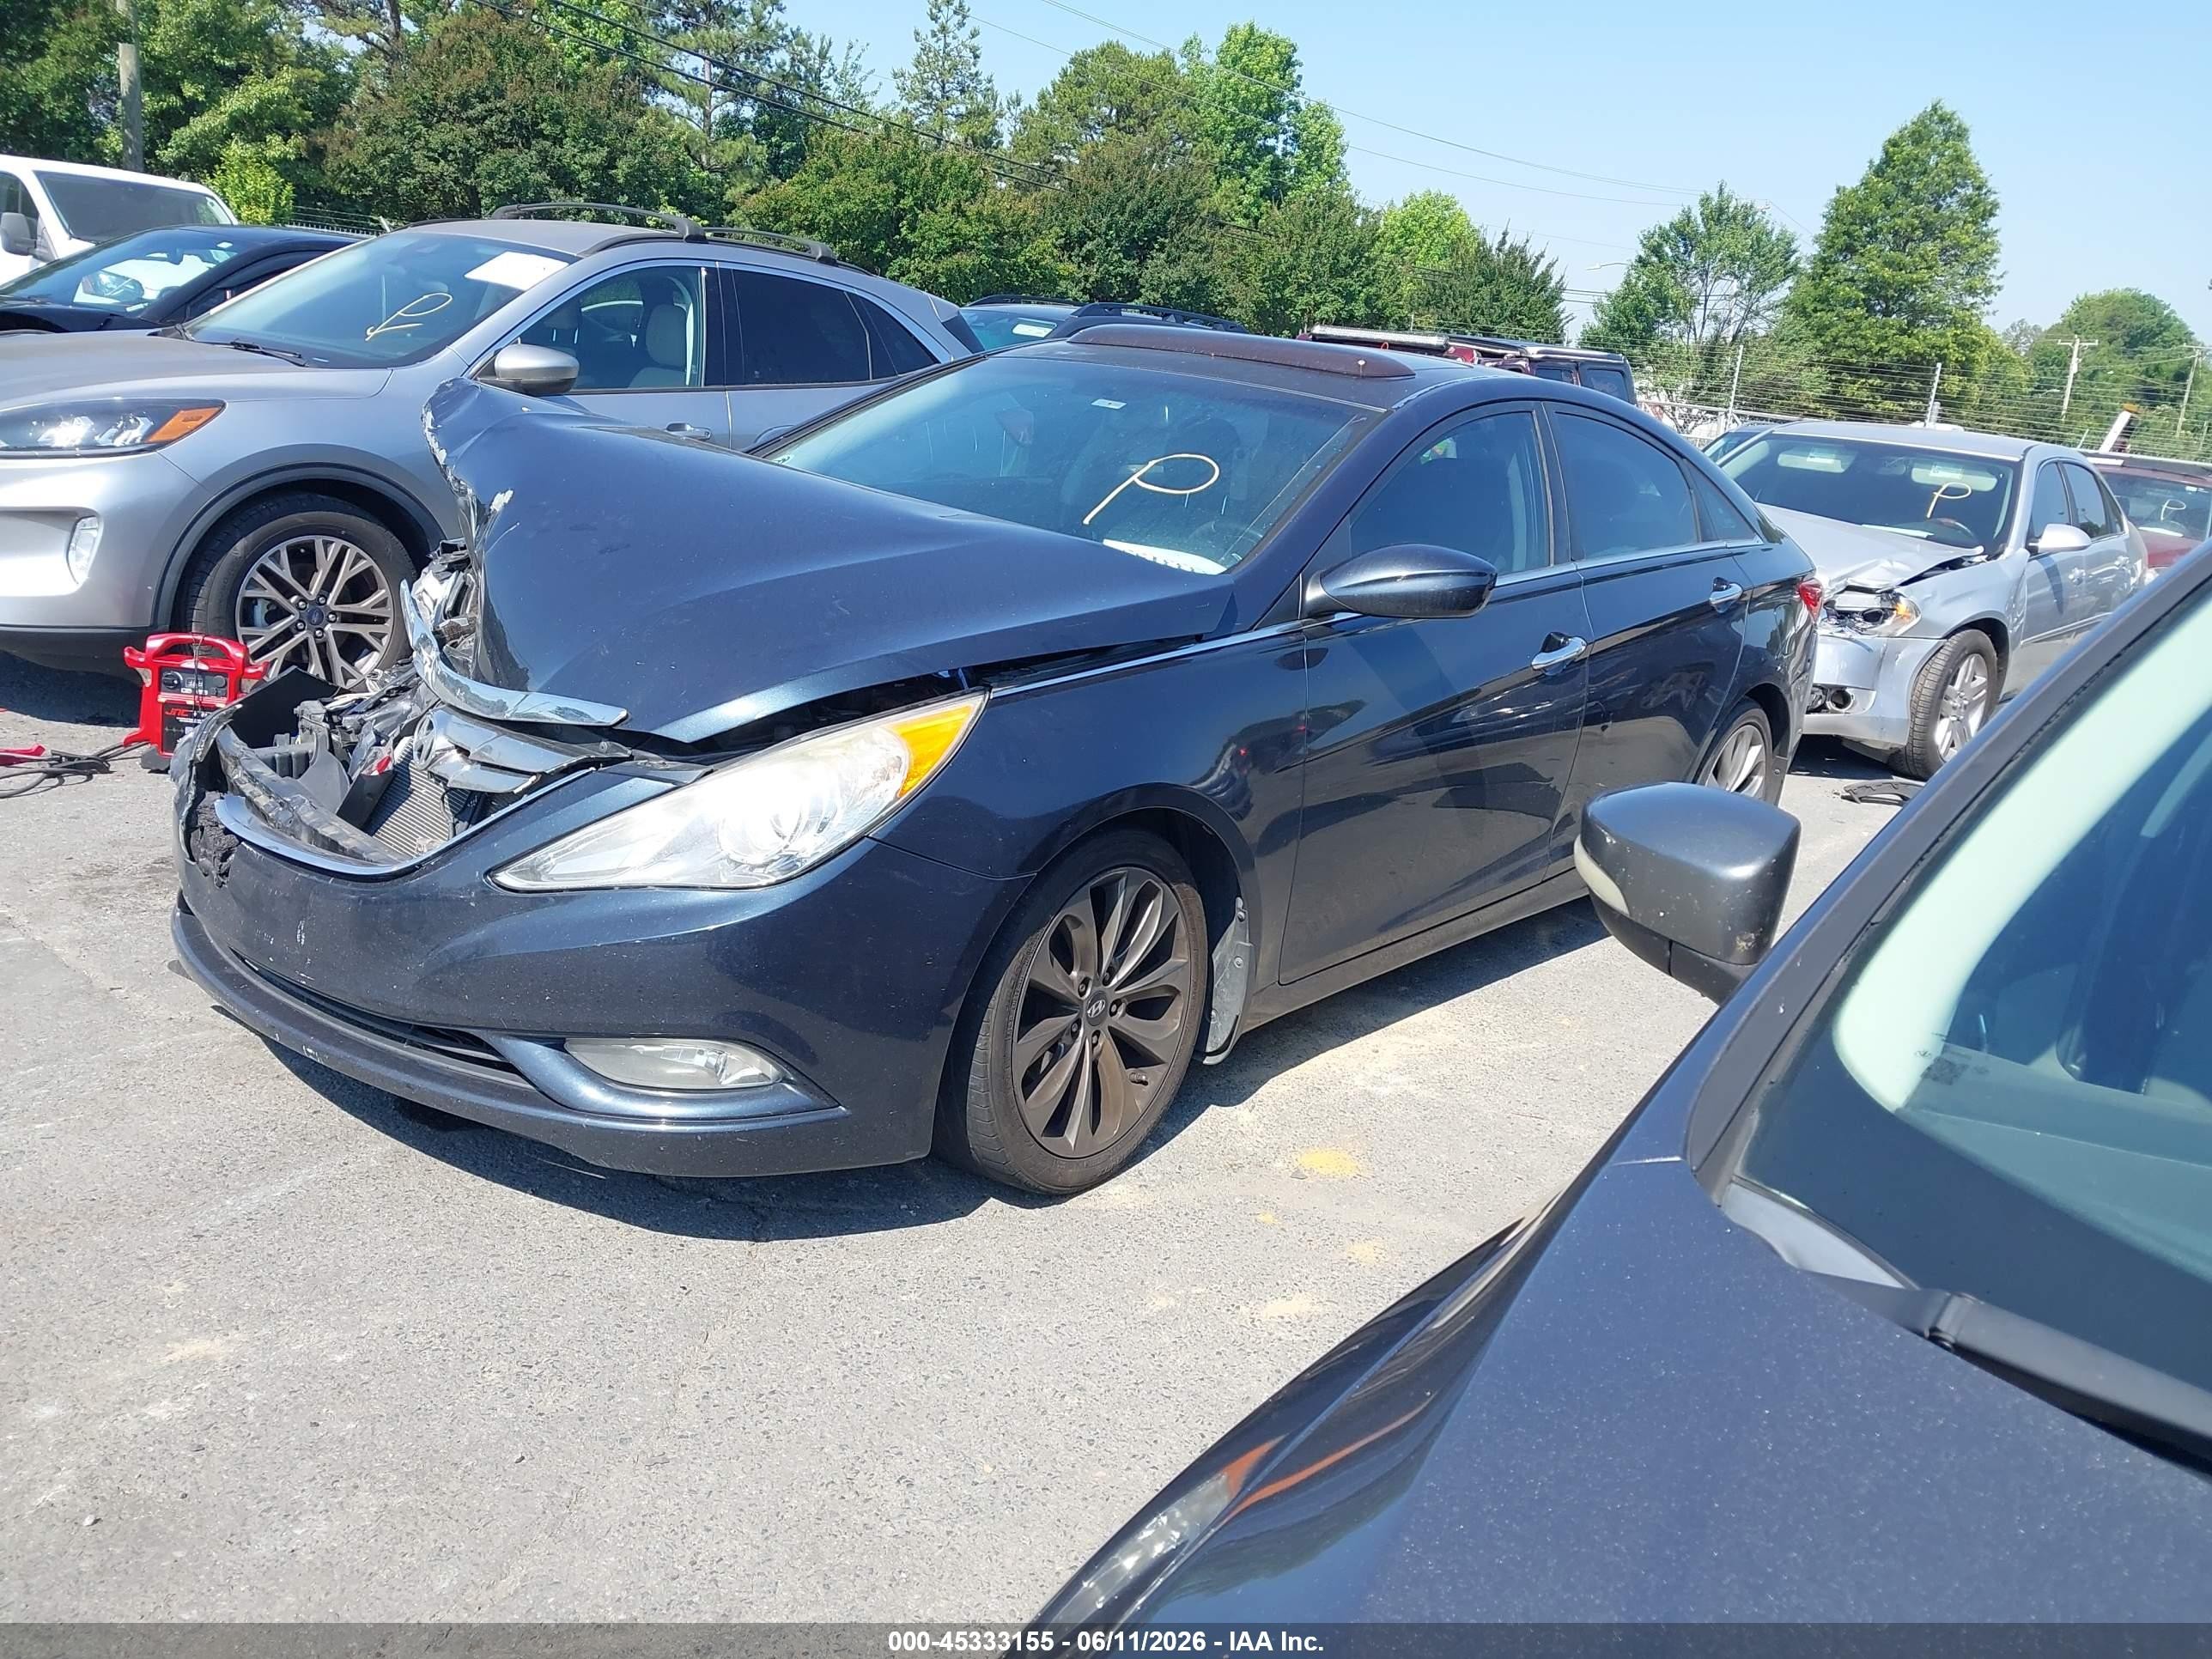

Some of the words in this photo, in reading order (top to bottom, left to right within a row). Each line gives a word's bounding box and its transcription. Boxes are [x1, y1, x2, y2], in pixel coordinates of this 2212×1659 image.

[1082, 453, 1220, 526] P
[1926, 481, 1972, 519] P
[2160, 498, 2187, 521] P
